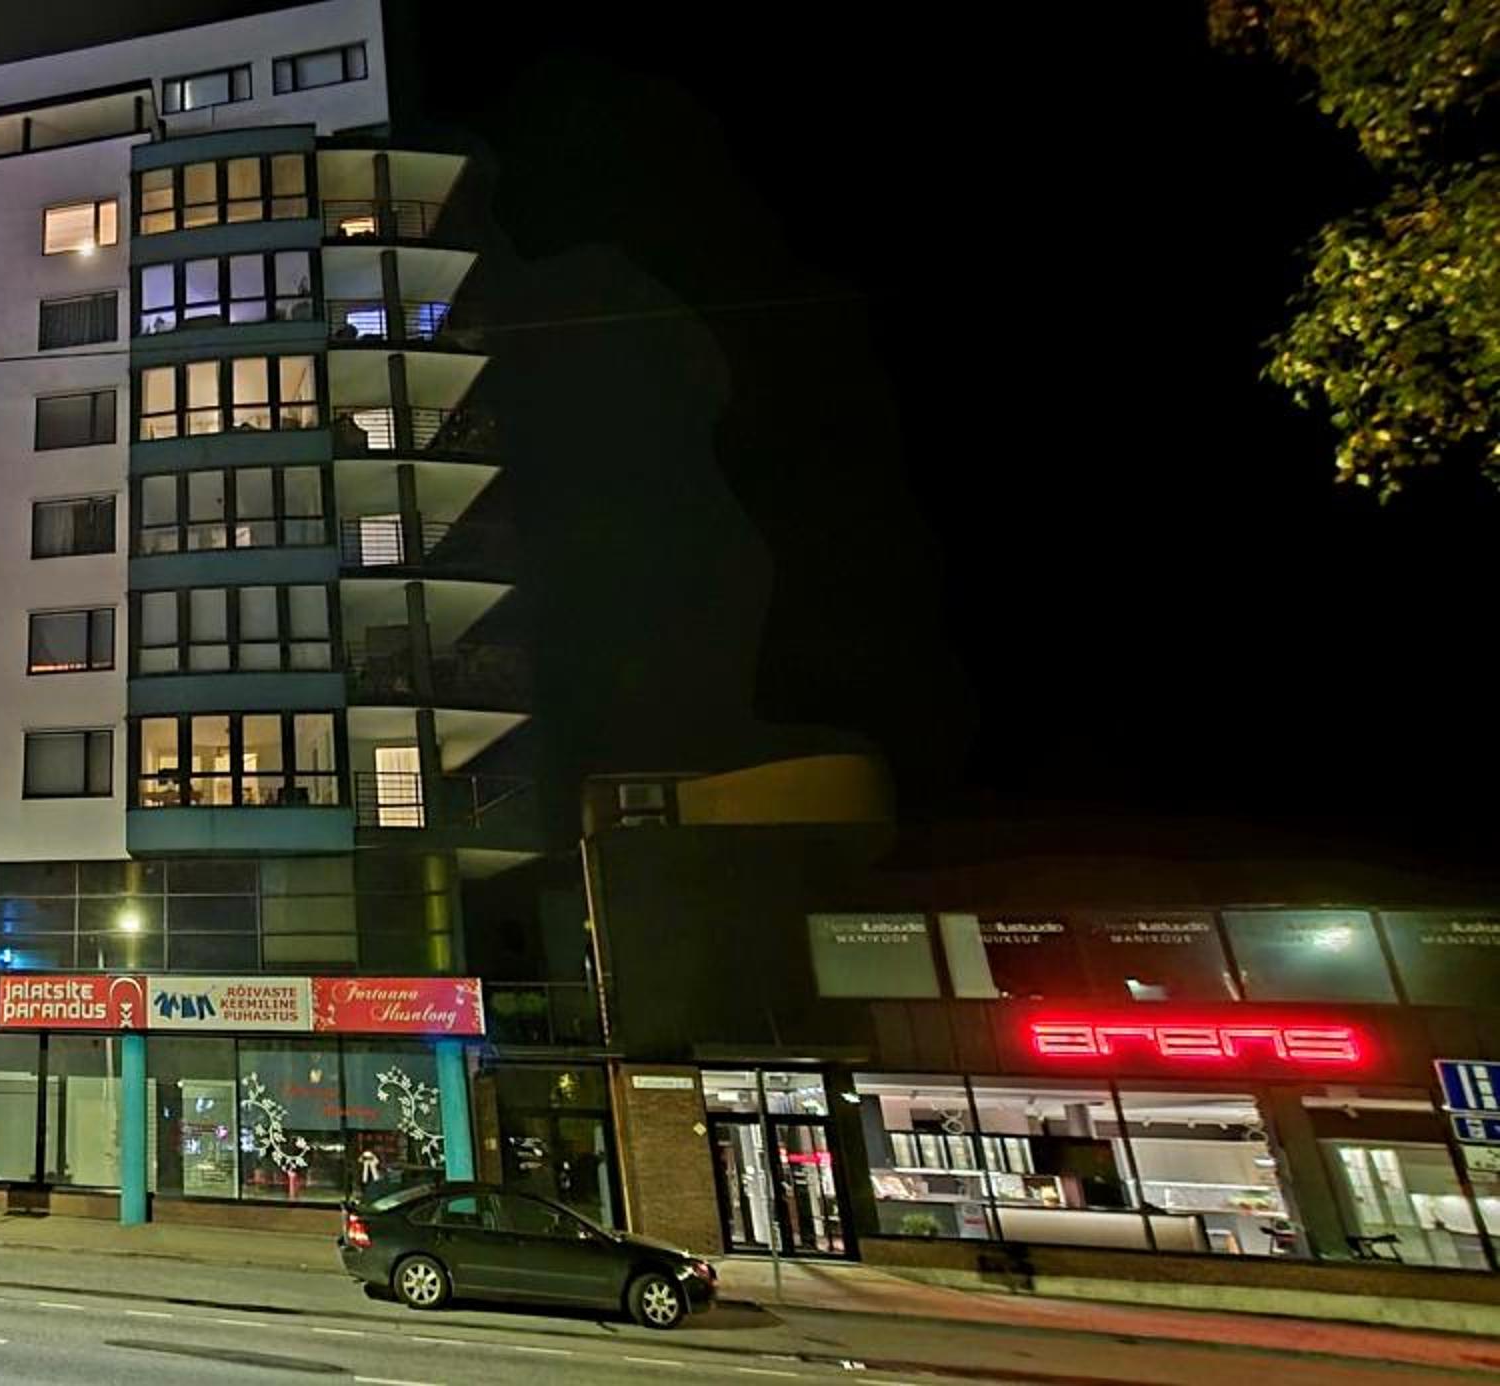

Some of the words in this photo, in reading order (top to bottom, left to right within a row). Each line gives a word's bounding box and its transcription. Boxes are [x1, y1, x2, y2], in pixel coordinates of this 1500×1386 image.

[227, 985, 297, 998] RÕIVASTE
[220, 998, 297, 1010] KEEMILINE
[3, 1001, 106, 1022] parandus
[224, 1010, 299, 1022] PUHASTUS
[1031, 1022, 1360, 1062] arens
